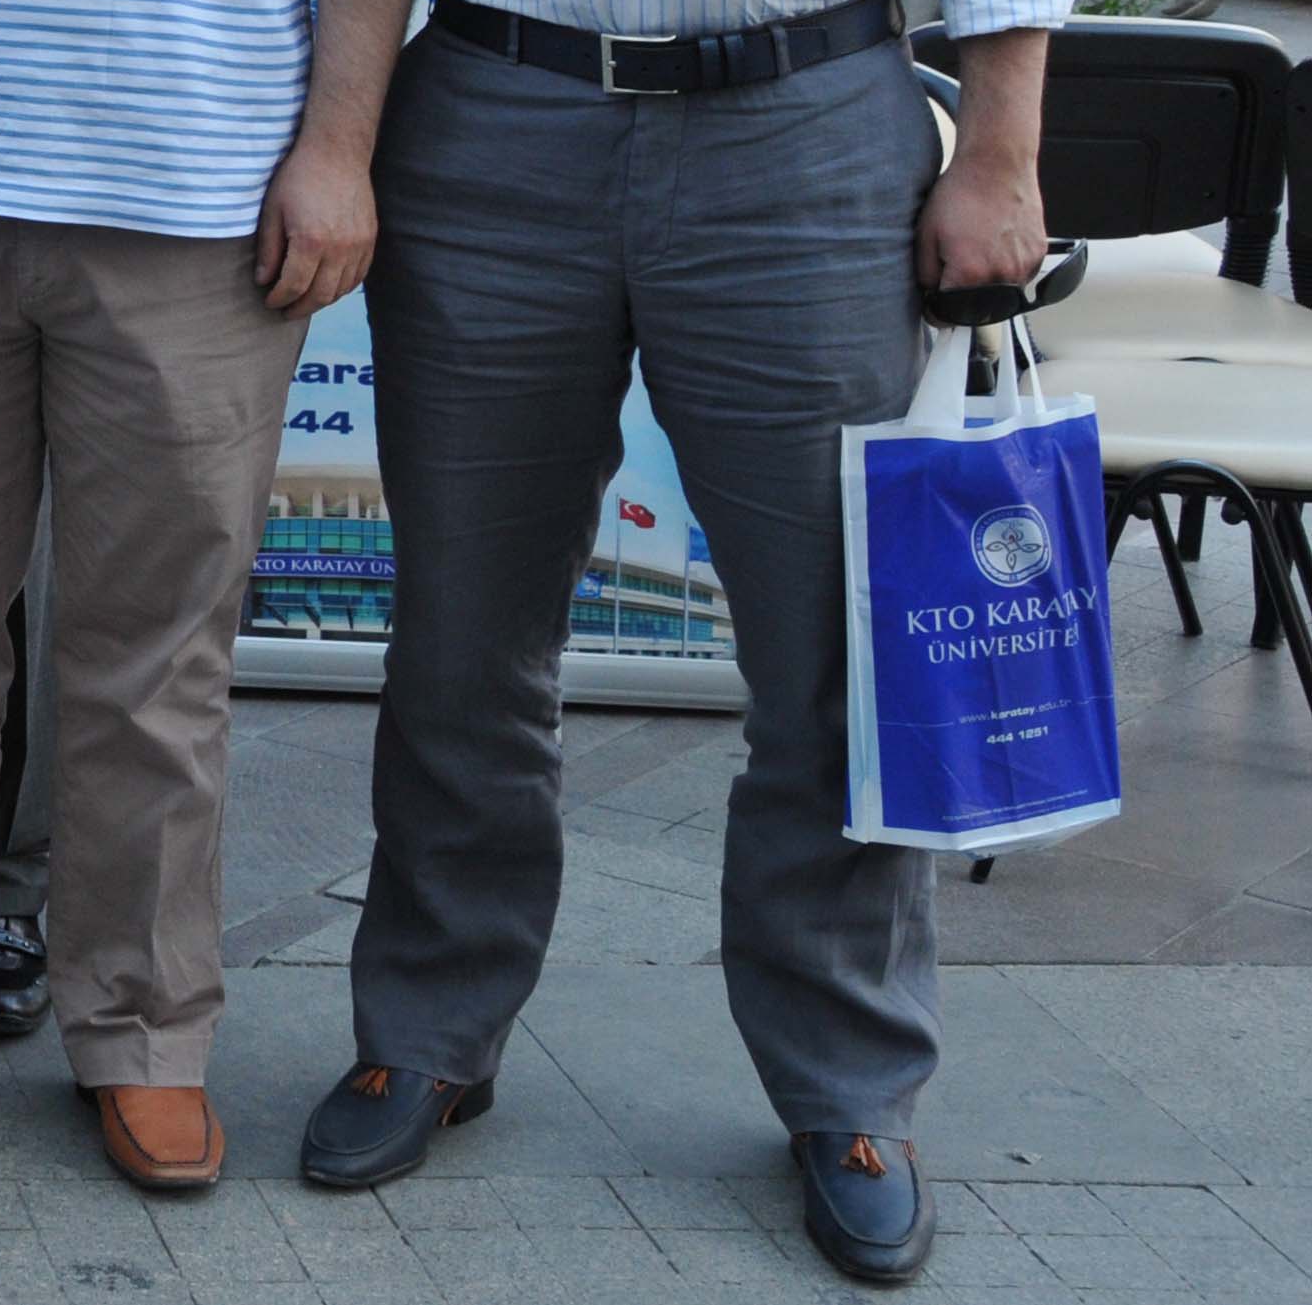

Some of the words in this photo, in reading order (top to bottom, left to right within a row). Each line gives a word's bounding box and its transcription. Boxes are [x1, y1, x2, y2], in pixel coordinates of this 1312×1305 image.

[283, 409, 354, 435] 44
[252, 558, 286, 572] KTO
[291, 558, 366, 574] KARATAY
[907, 604, 975, 635] KTO
[987, 585, 1098, 628] KARATAY
[928, 618, 1080, 664] ÜNİVERSİTEİ
[986, 731, 1014, 744] 444
[1018, 725, 1049, 741] 1251
